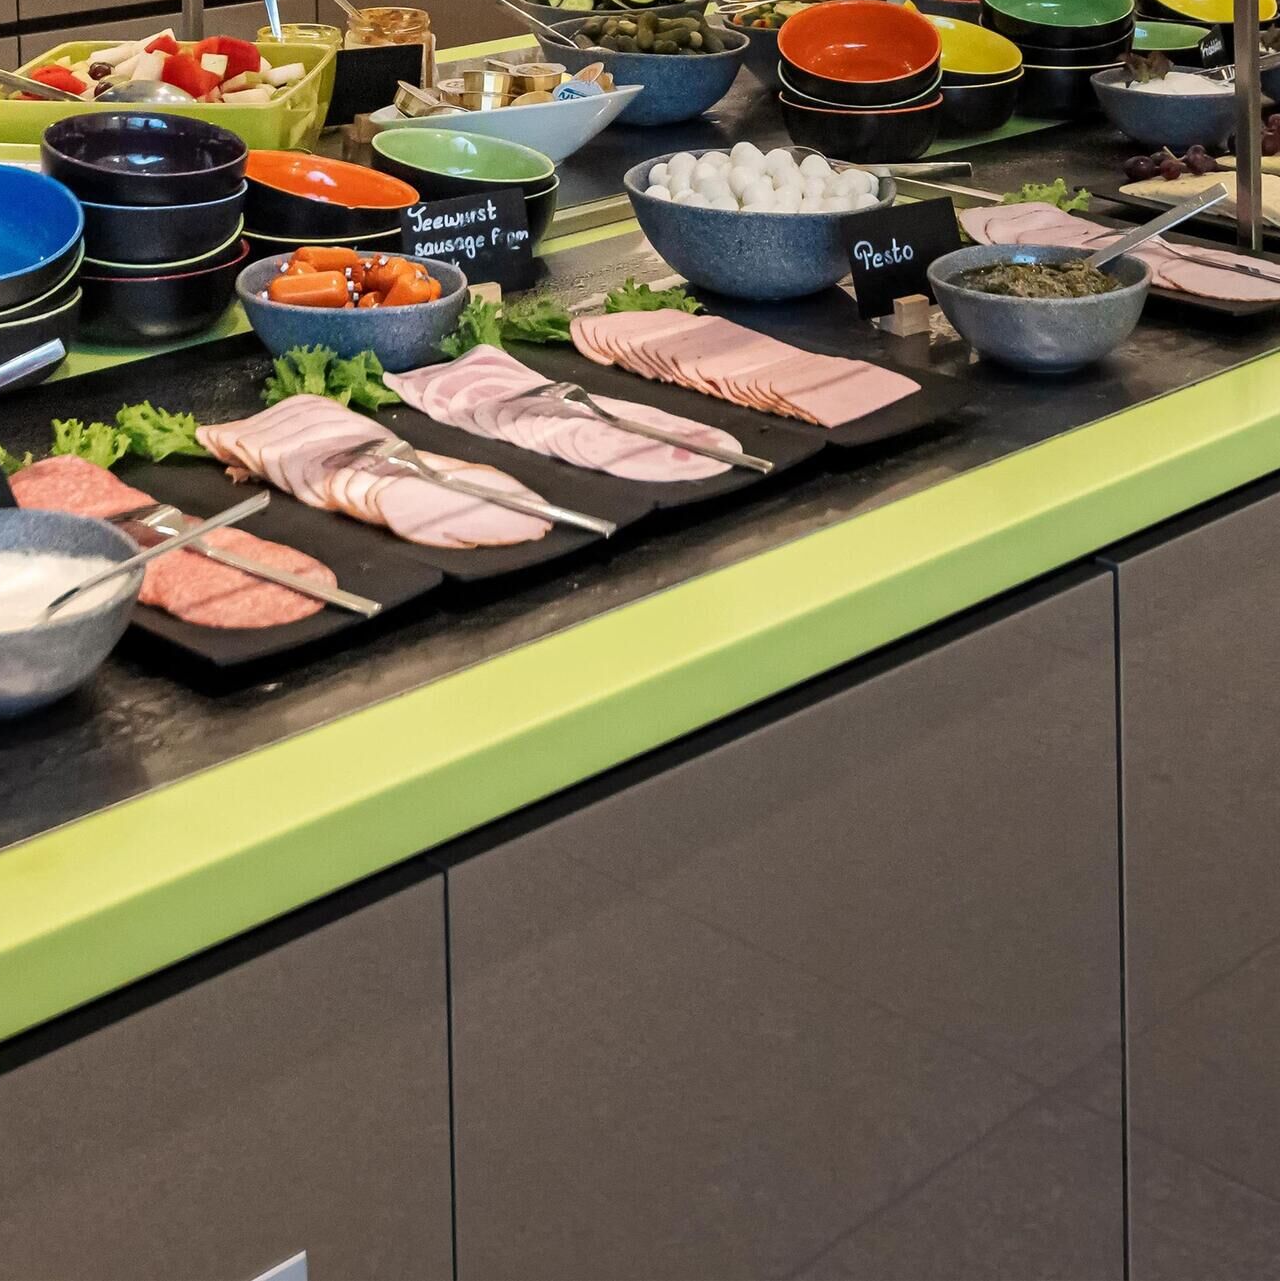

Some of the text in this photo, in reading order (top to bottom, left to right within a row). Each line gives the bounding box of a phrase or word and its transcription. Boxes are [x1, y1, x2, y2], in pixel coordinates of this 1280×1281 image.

[407, 199, 497, 232] Teewurst
[414, 234, 485, 259] sausage
[854, 237, 914, 271] Pesto
